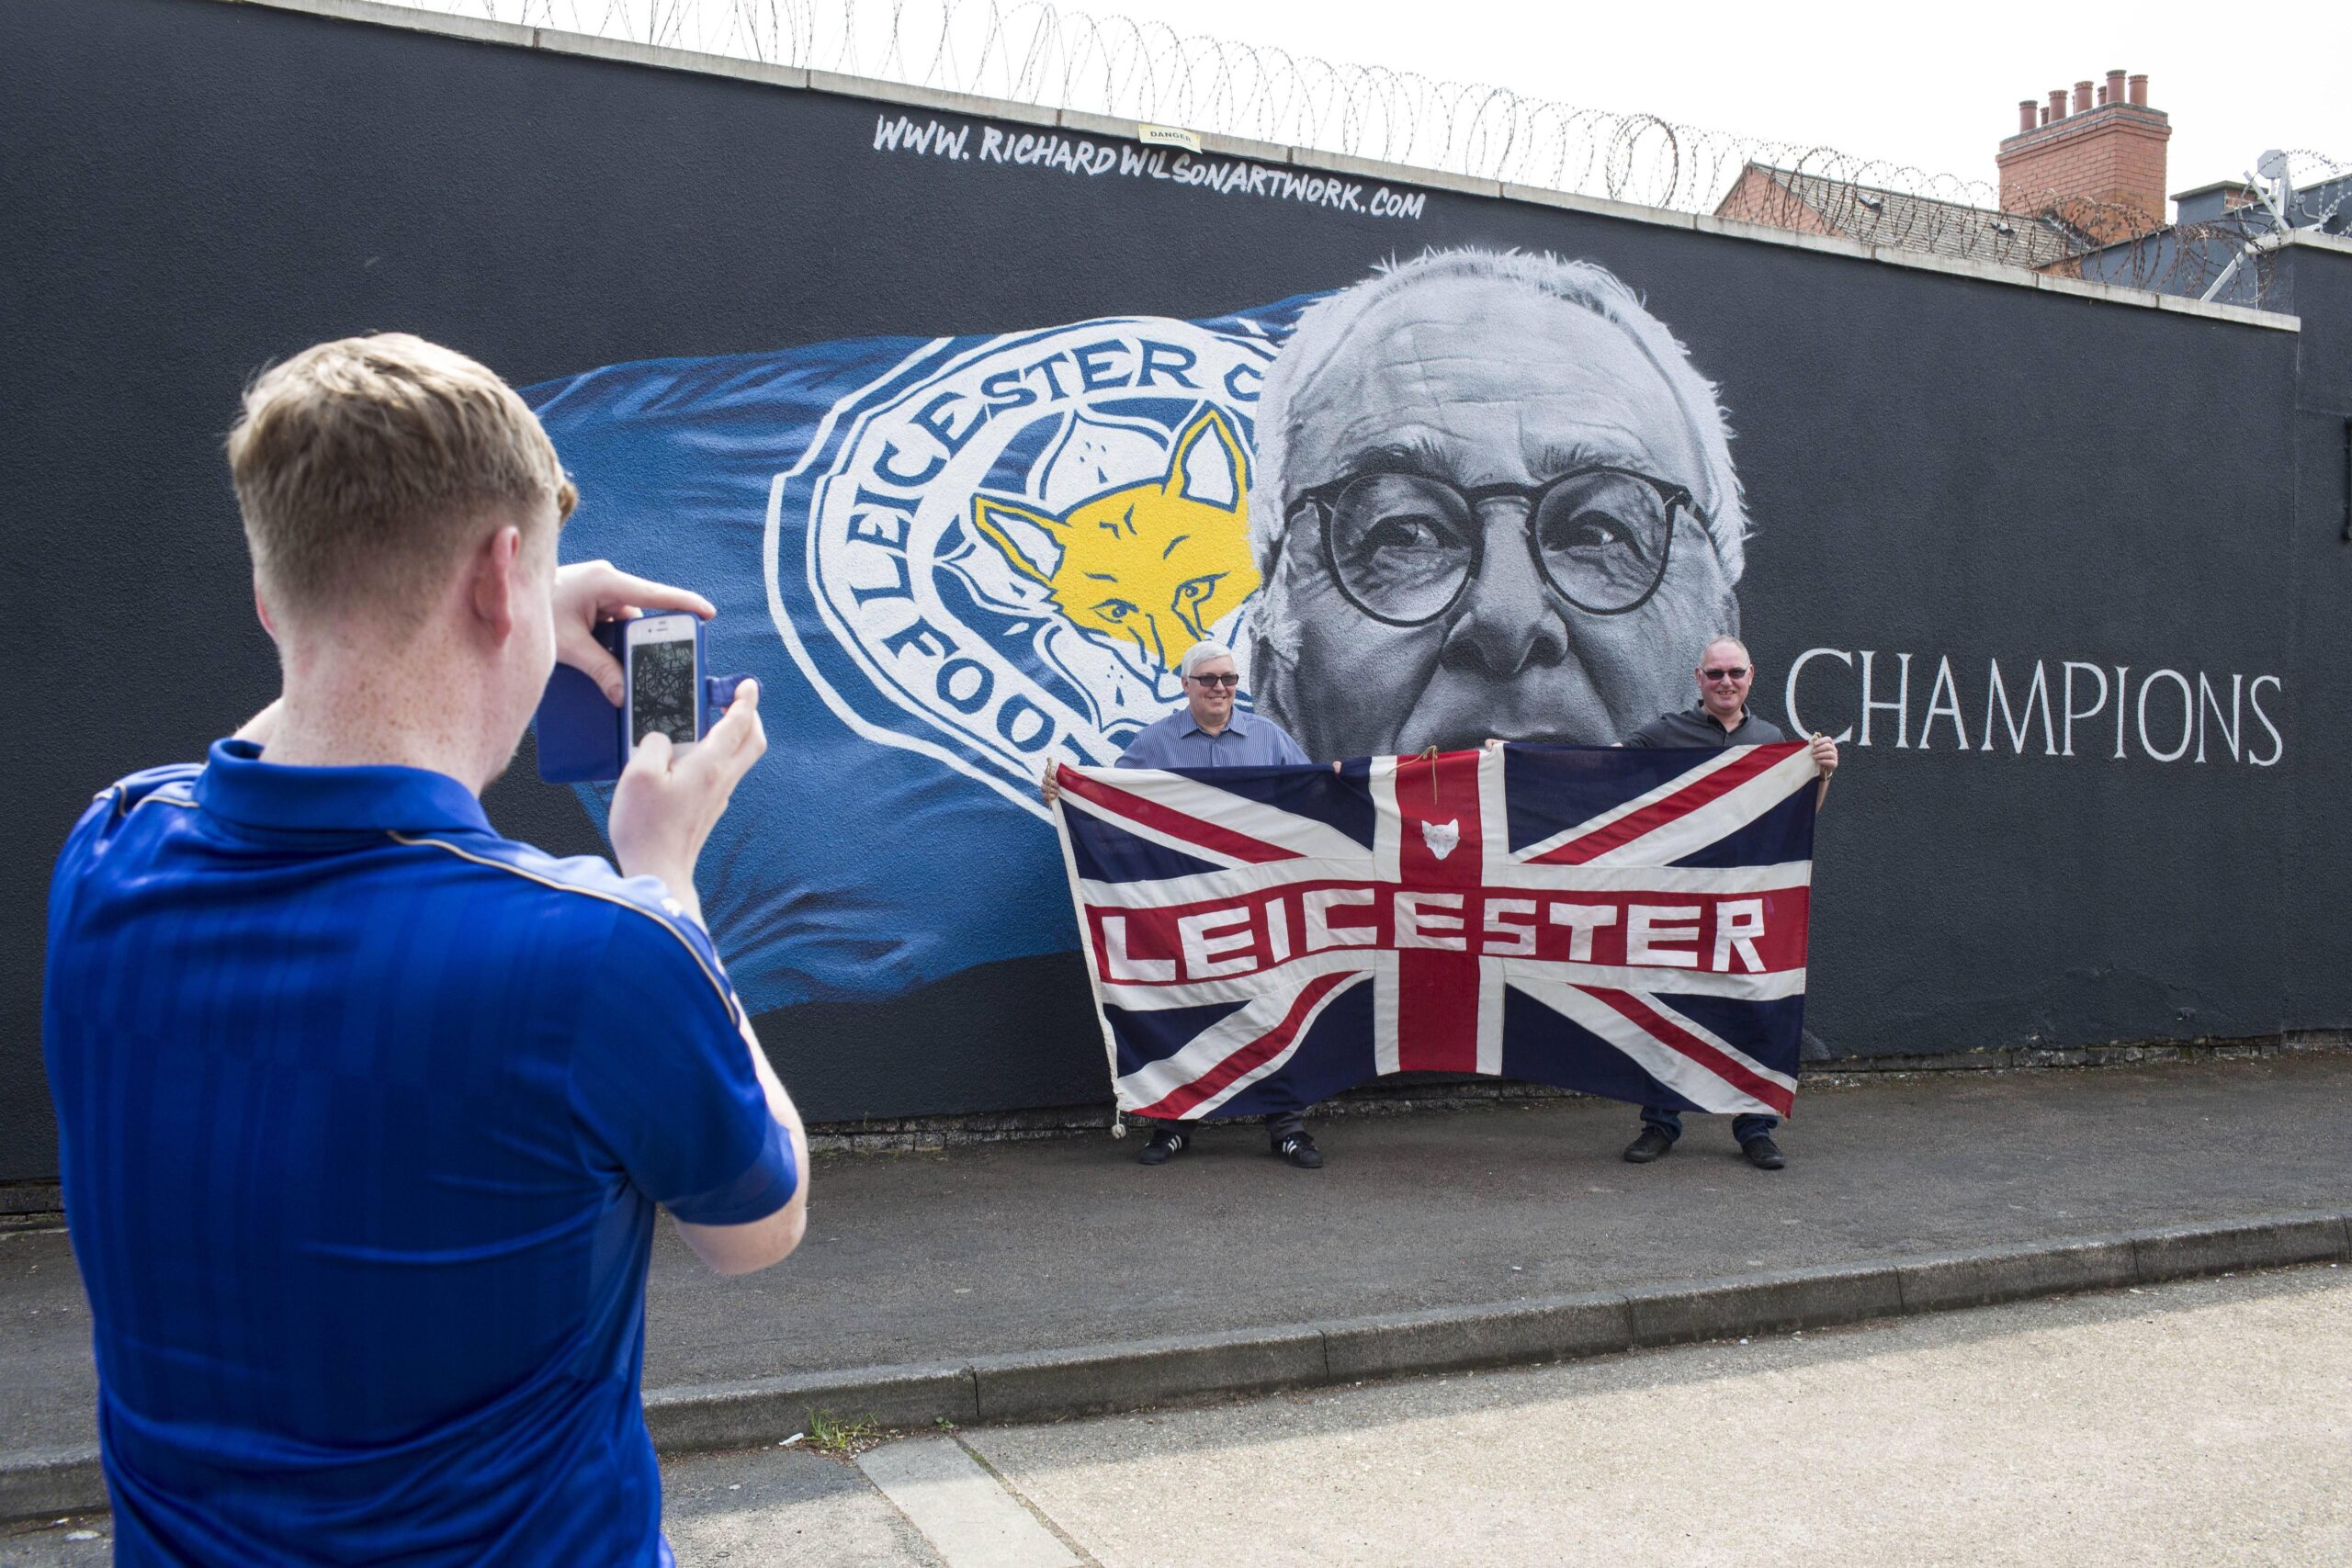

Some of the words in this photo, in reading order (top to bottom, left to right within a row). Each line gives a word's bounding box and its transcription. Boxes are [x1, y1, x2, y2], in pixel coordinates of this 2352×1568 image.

[1149, 130, 1192, 143] DANGER
[847, 337, 1205, 610] LEICESTER
[1785, 648, 2284, 766] CHAMPIONS
[1101, 887, 1766, 983] LEICESTER
